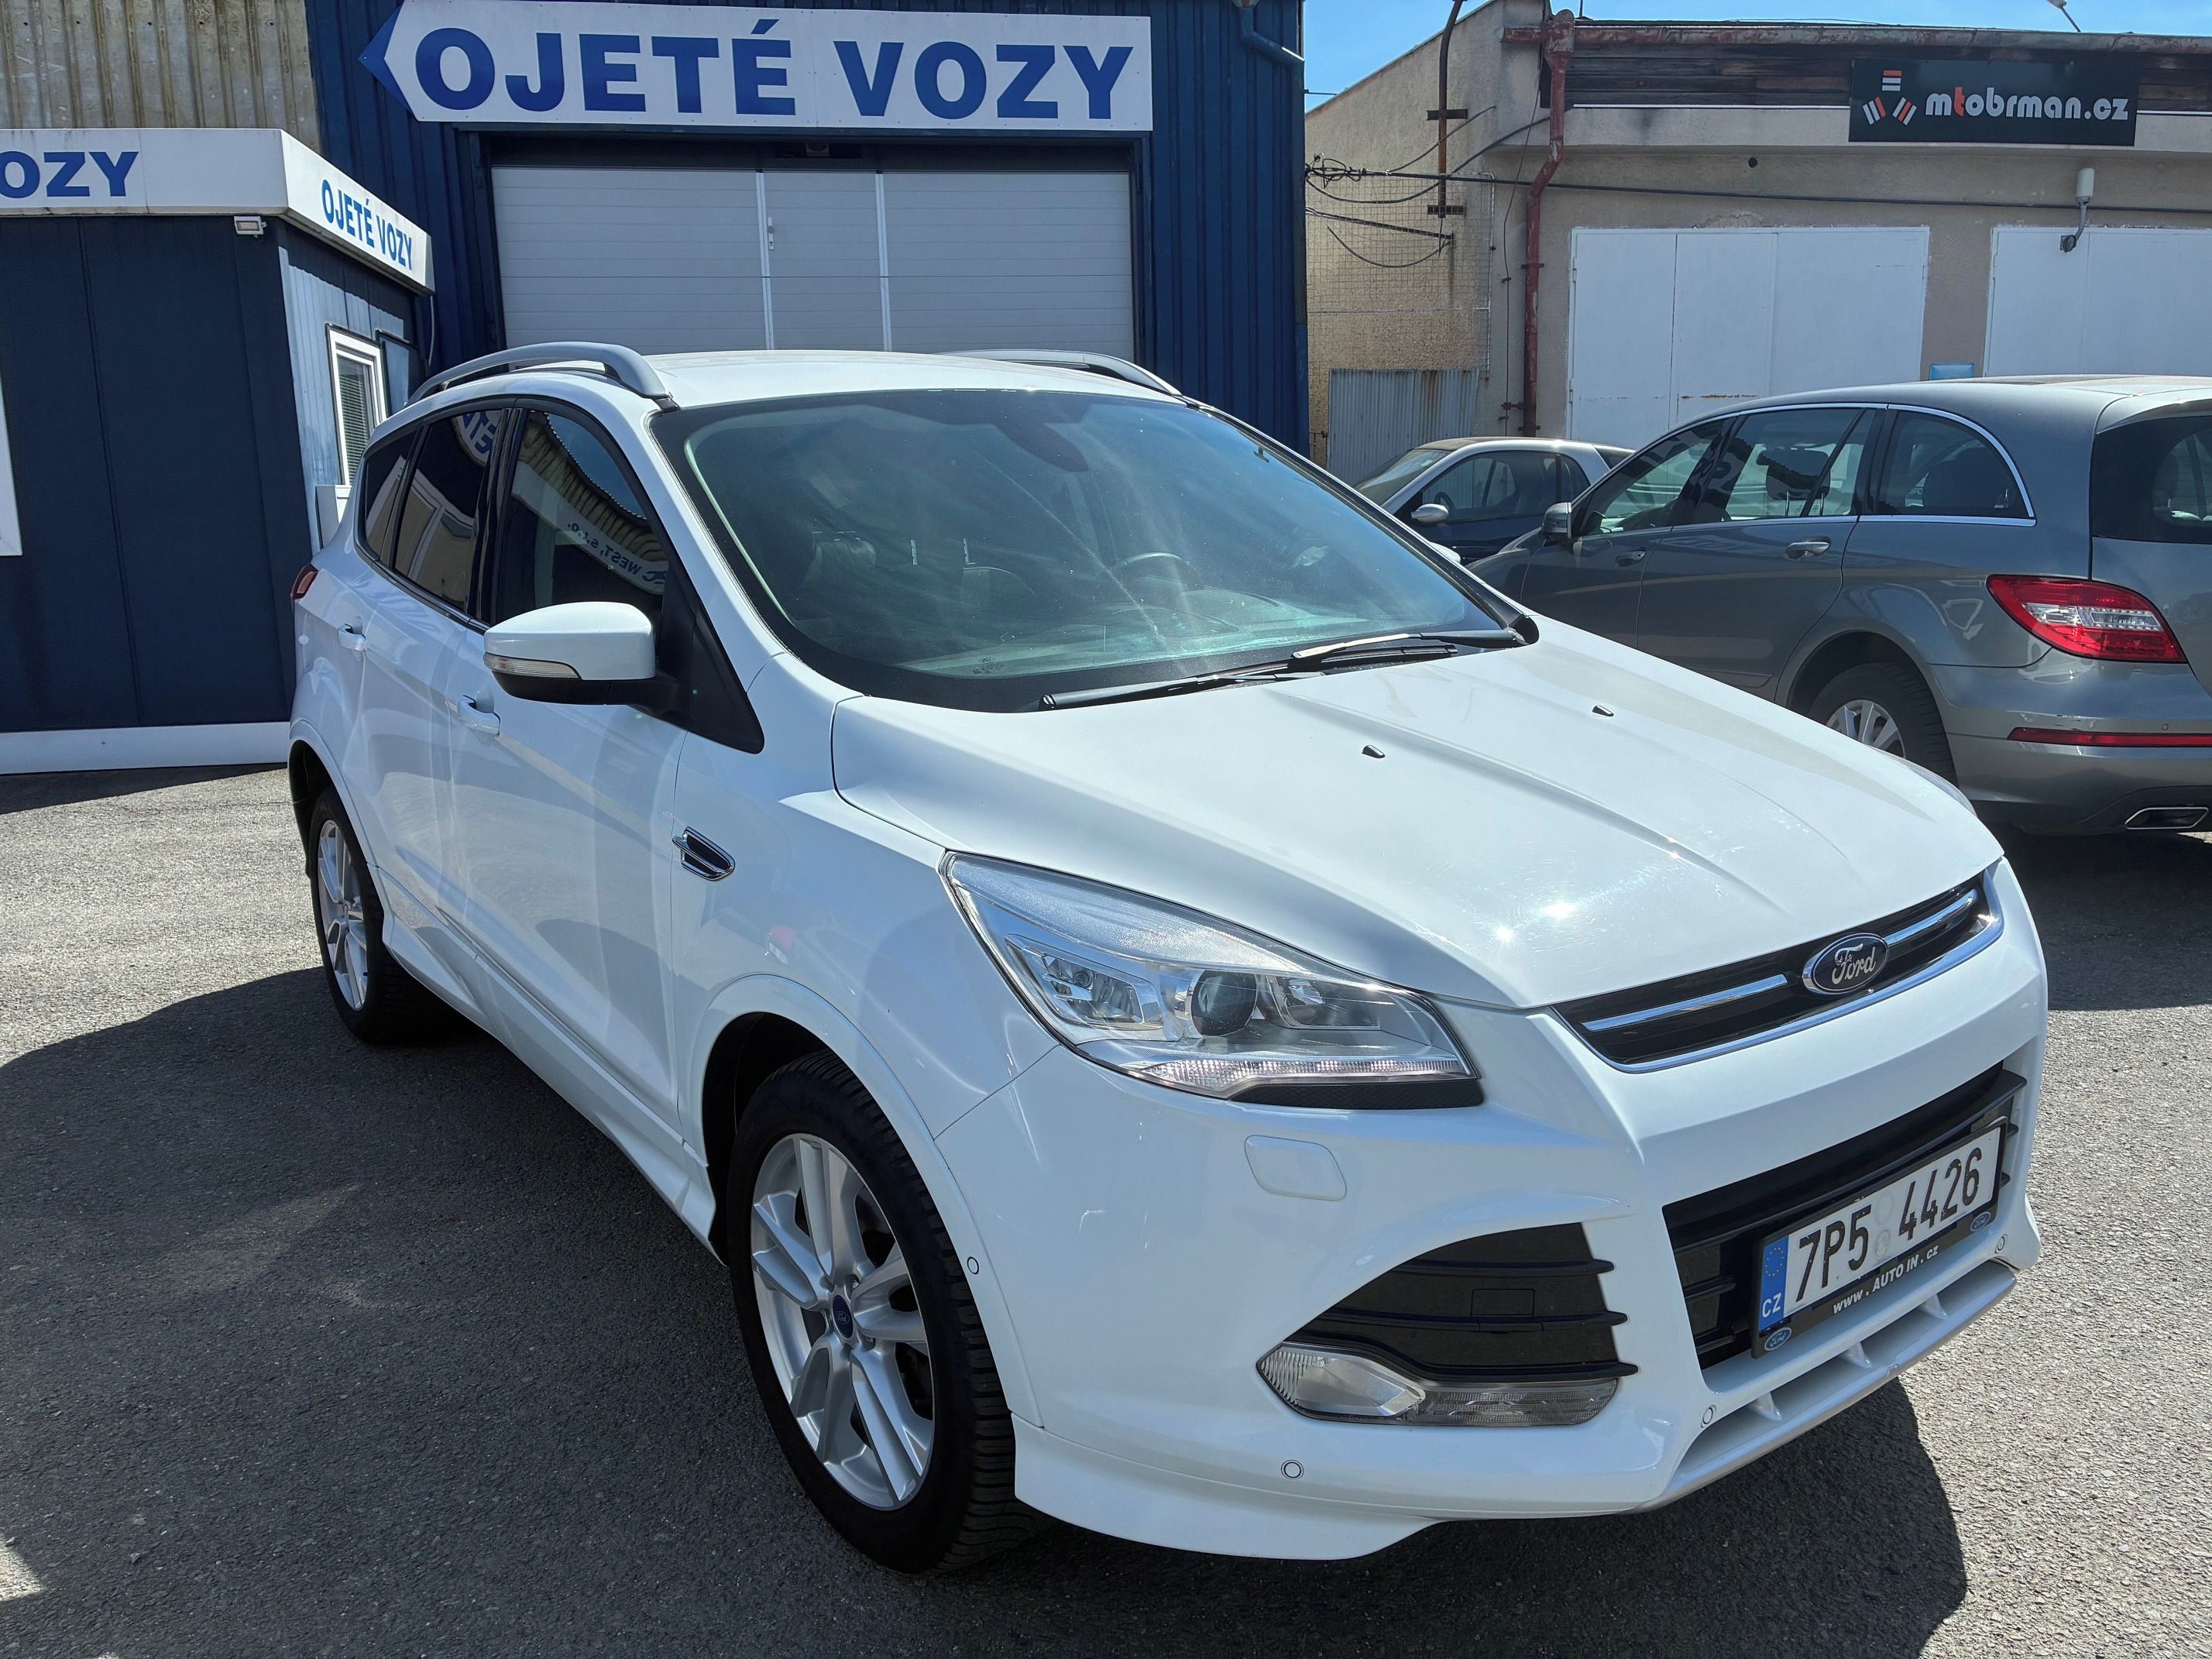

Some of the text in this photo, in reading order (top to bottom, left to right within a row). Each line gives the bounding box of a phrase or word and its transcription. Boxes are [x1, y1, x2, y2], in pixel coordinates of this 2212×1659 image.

[416, 19, 1133, 119] OJETÉ VOZY
[1925, 87, 2129, 120] mtobrman.cz
[321, 180, 411, 270] OJETÉ VOZY
[1832, 943, 1876, 984] Ford
[1796, 1147, 1982, 1302] 7P5 4426
[1762, 1292, 1781, 1318] CZ
